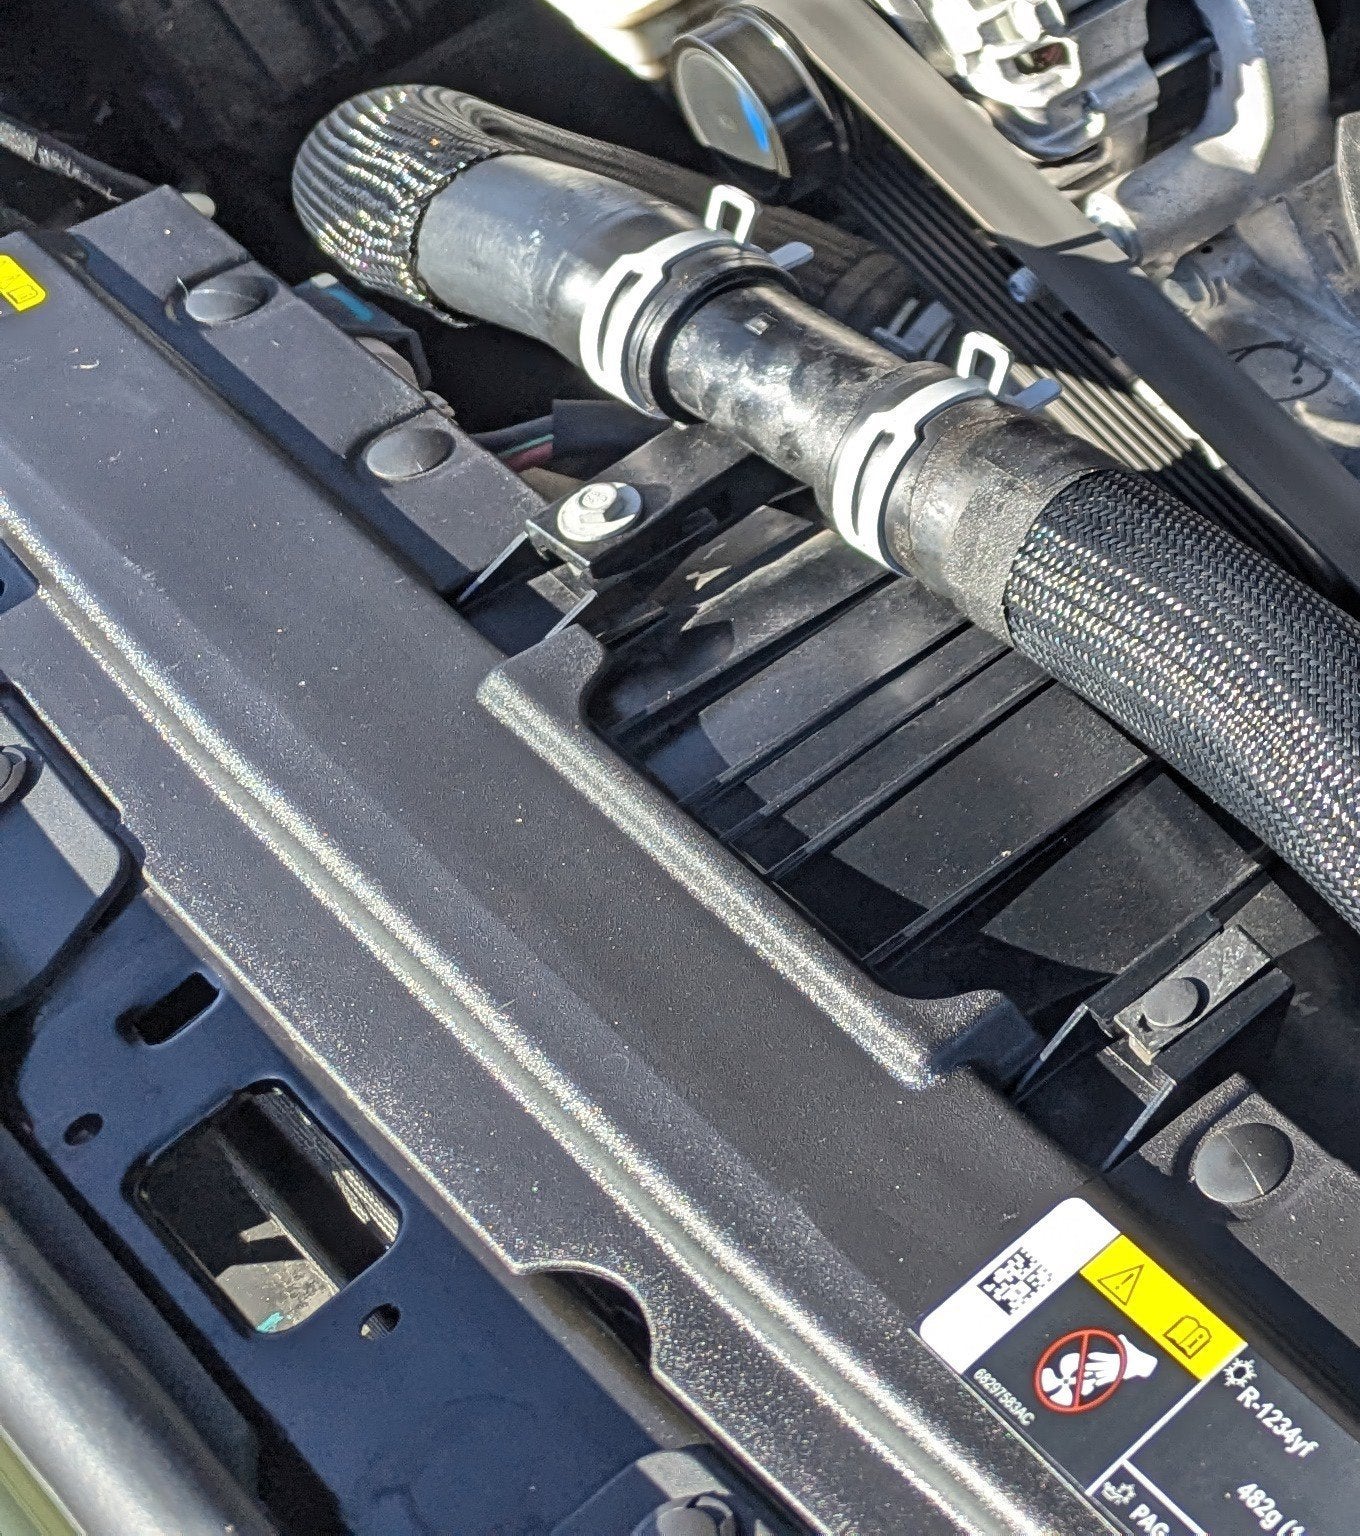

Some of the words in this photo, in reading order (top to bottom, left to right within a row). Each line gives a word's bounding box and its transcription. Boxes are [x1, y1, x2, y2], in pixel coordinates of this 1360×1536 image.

[973, 1368, 1036, 1427] 68297583AC
[1236, 1385, 1320, 1458] R-1234yf
[1236, 1483, 1284, 1531] 482g
